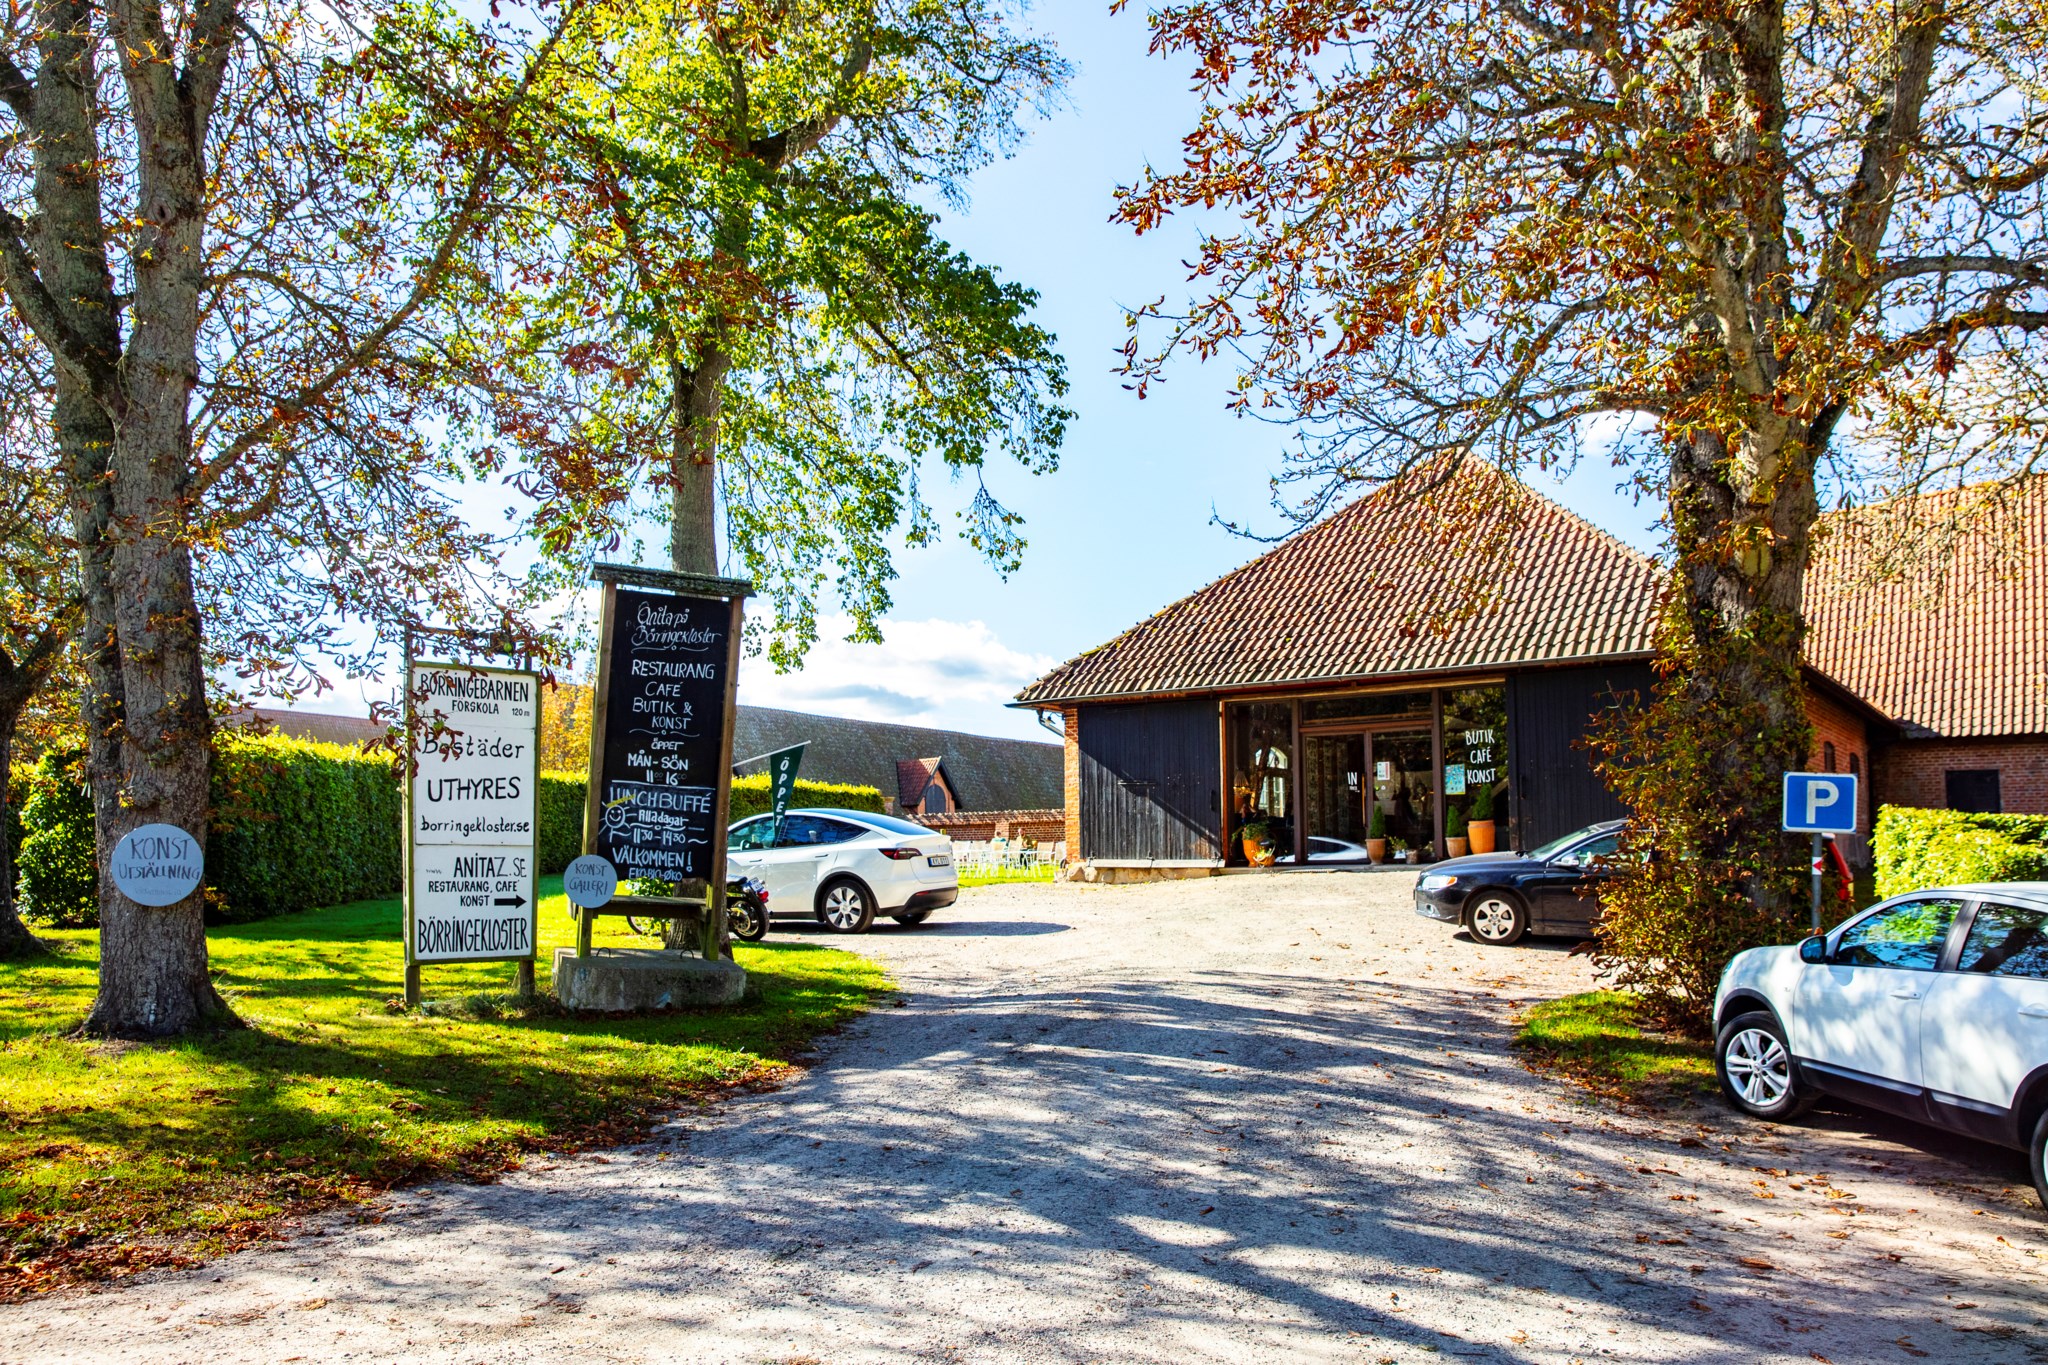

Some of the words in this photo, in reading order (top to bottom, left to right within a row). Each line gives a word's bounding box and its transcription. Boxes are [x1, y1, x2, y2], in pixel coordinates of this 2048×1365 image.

[631, 659, 716, 679] RESTAURANG
[645, 681, 684, 697] CAFÉ
[451, 697, 499, 715] FÖRSKOLA
[632, 696, 677, 715] BUTIK
[683, 702, 693, 716] &
[651, 716, 691, 730] KONST
[651, 737, 684, 751] ÖPPET
[1465, 728, 1495, 746] BUTIK
[1470, 746, 1492, 764] CAFÉ
[1347, 771, 1358, 786] IN
[1466, 768, 1496, 784] KONST
[427, 776, 521, 802] UTHYRES
[775, 756, 790, 827] ÖPPET
[1806, 780, 1840, 825] P
[420, 814, 530, 837] borringekloster.se
[130, 836, 191, 860] KONST
[118, 861, 200, 880] UTSTÄLLNING
[575, 863, 607, 877] KONST
[569, 876, 608, 897] GALLERI
[460, 895, 490, 906] KONST
[417, 915, 529, 954] BÖRRINGEKLOSTER
